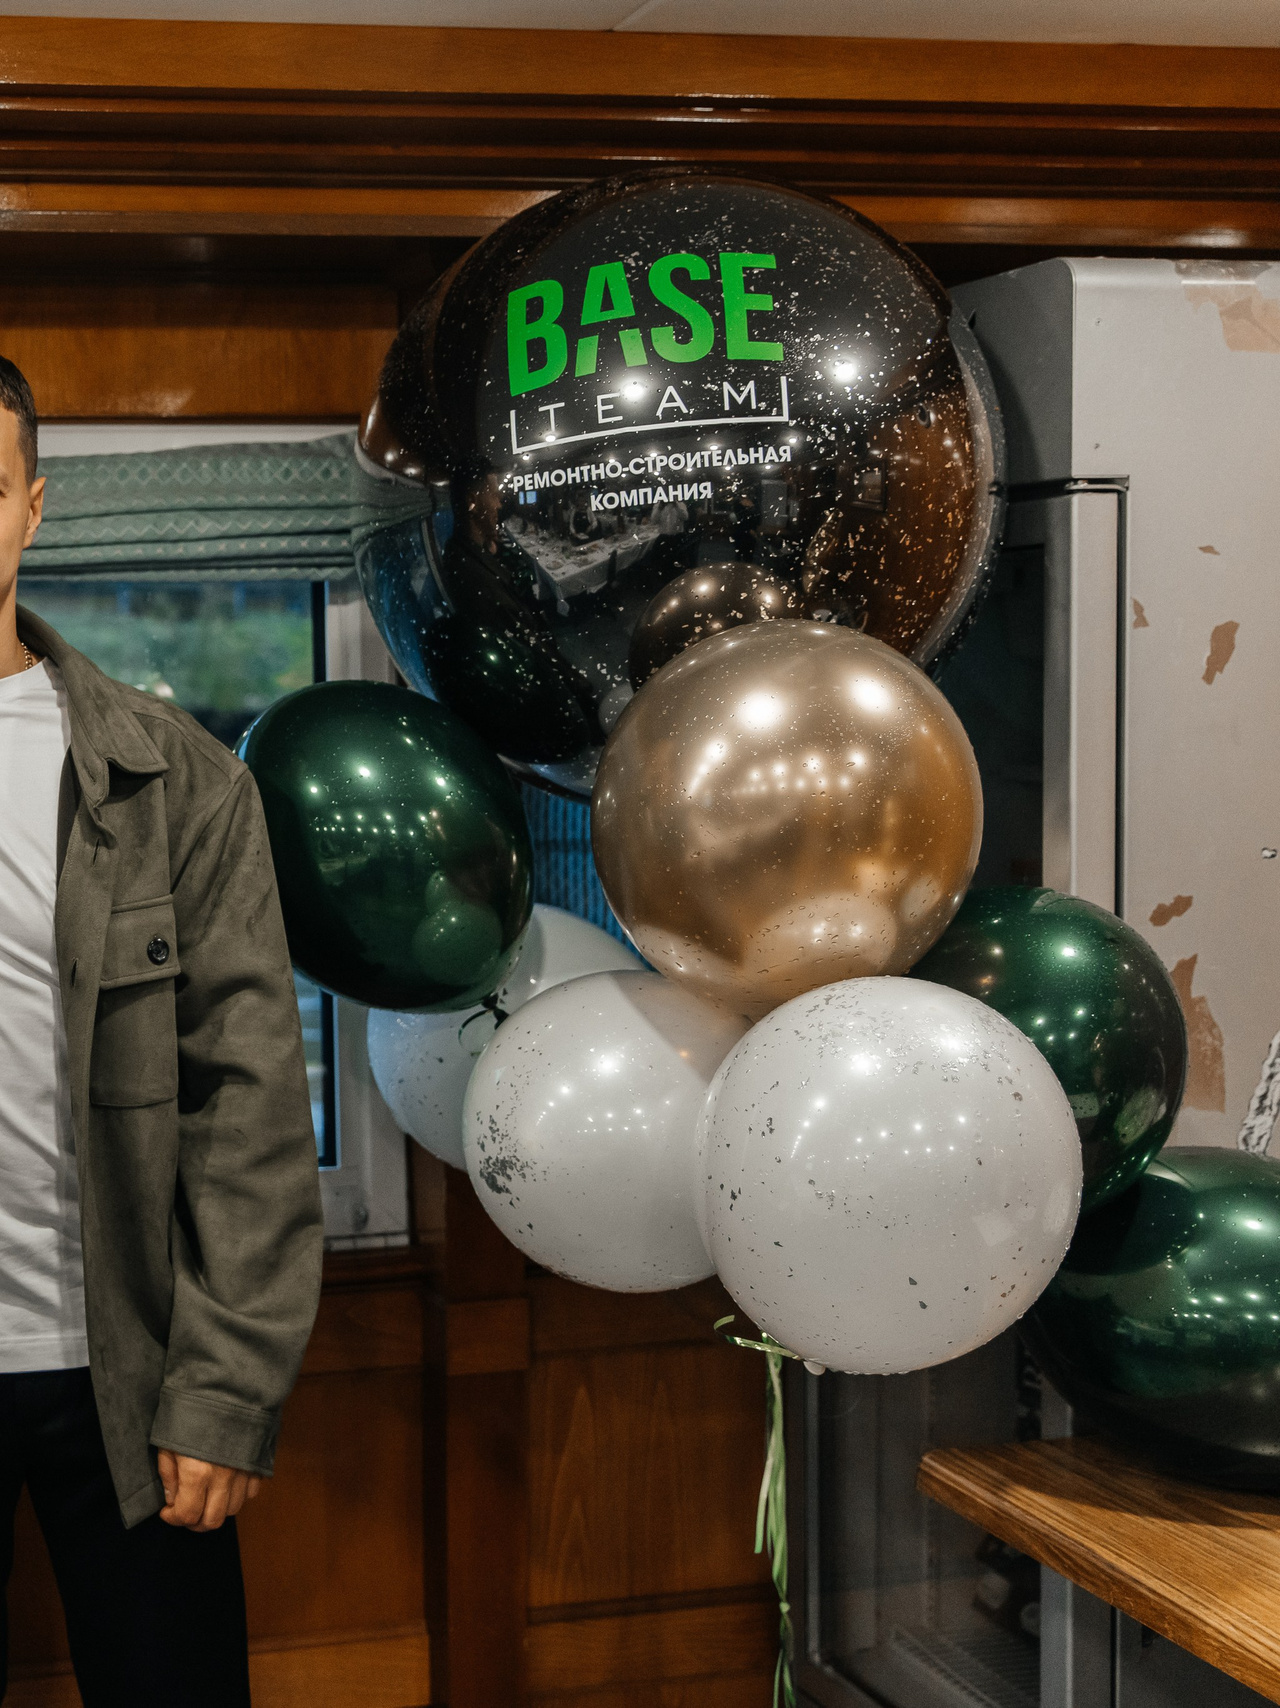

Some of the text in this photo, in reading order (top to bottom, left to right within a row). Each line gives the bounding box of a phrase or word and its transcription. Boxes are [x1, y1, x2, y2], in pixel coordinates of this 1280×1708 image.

[508, 252, 784, 396] BASE
[539, 381, 757, 434] TEAM
[513, 446, 791, 492] РЕМОНТНО-СТРОИТЕЛЬНАЯ
[589, 482, 713, 512] КОМПАНИЯ
